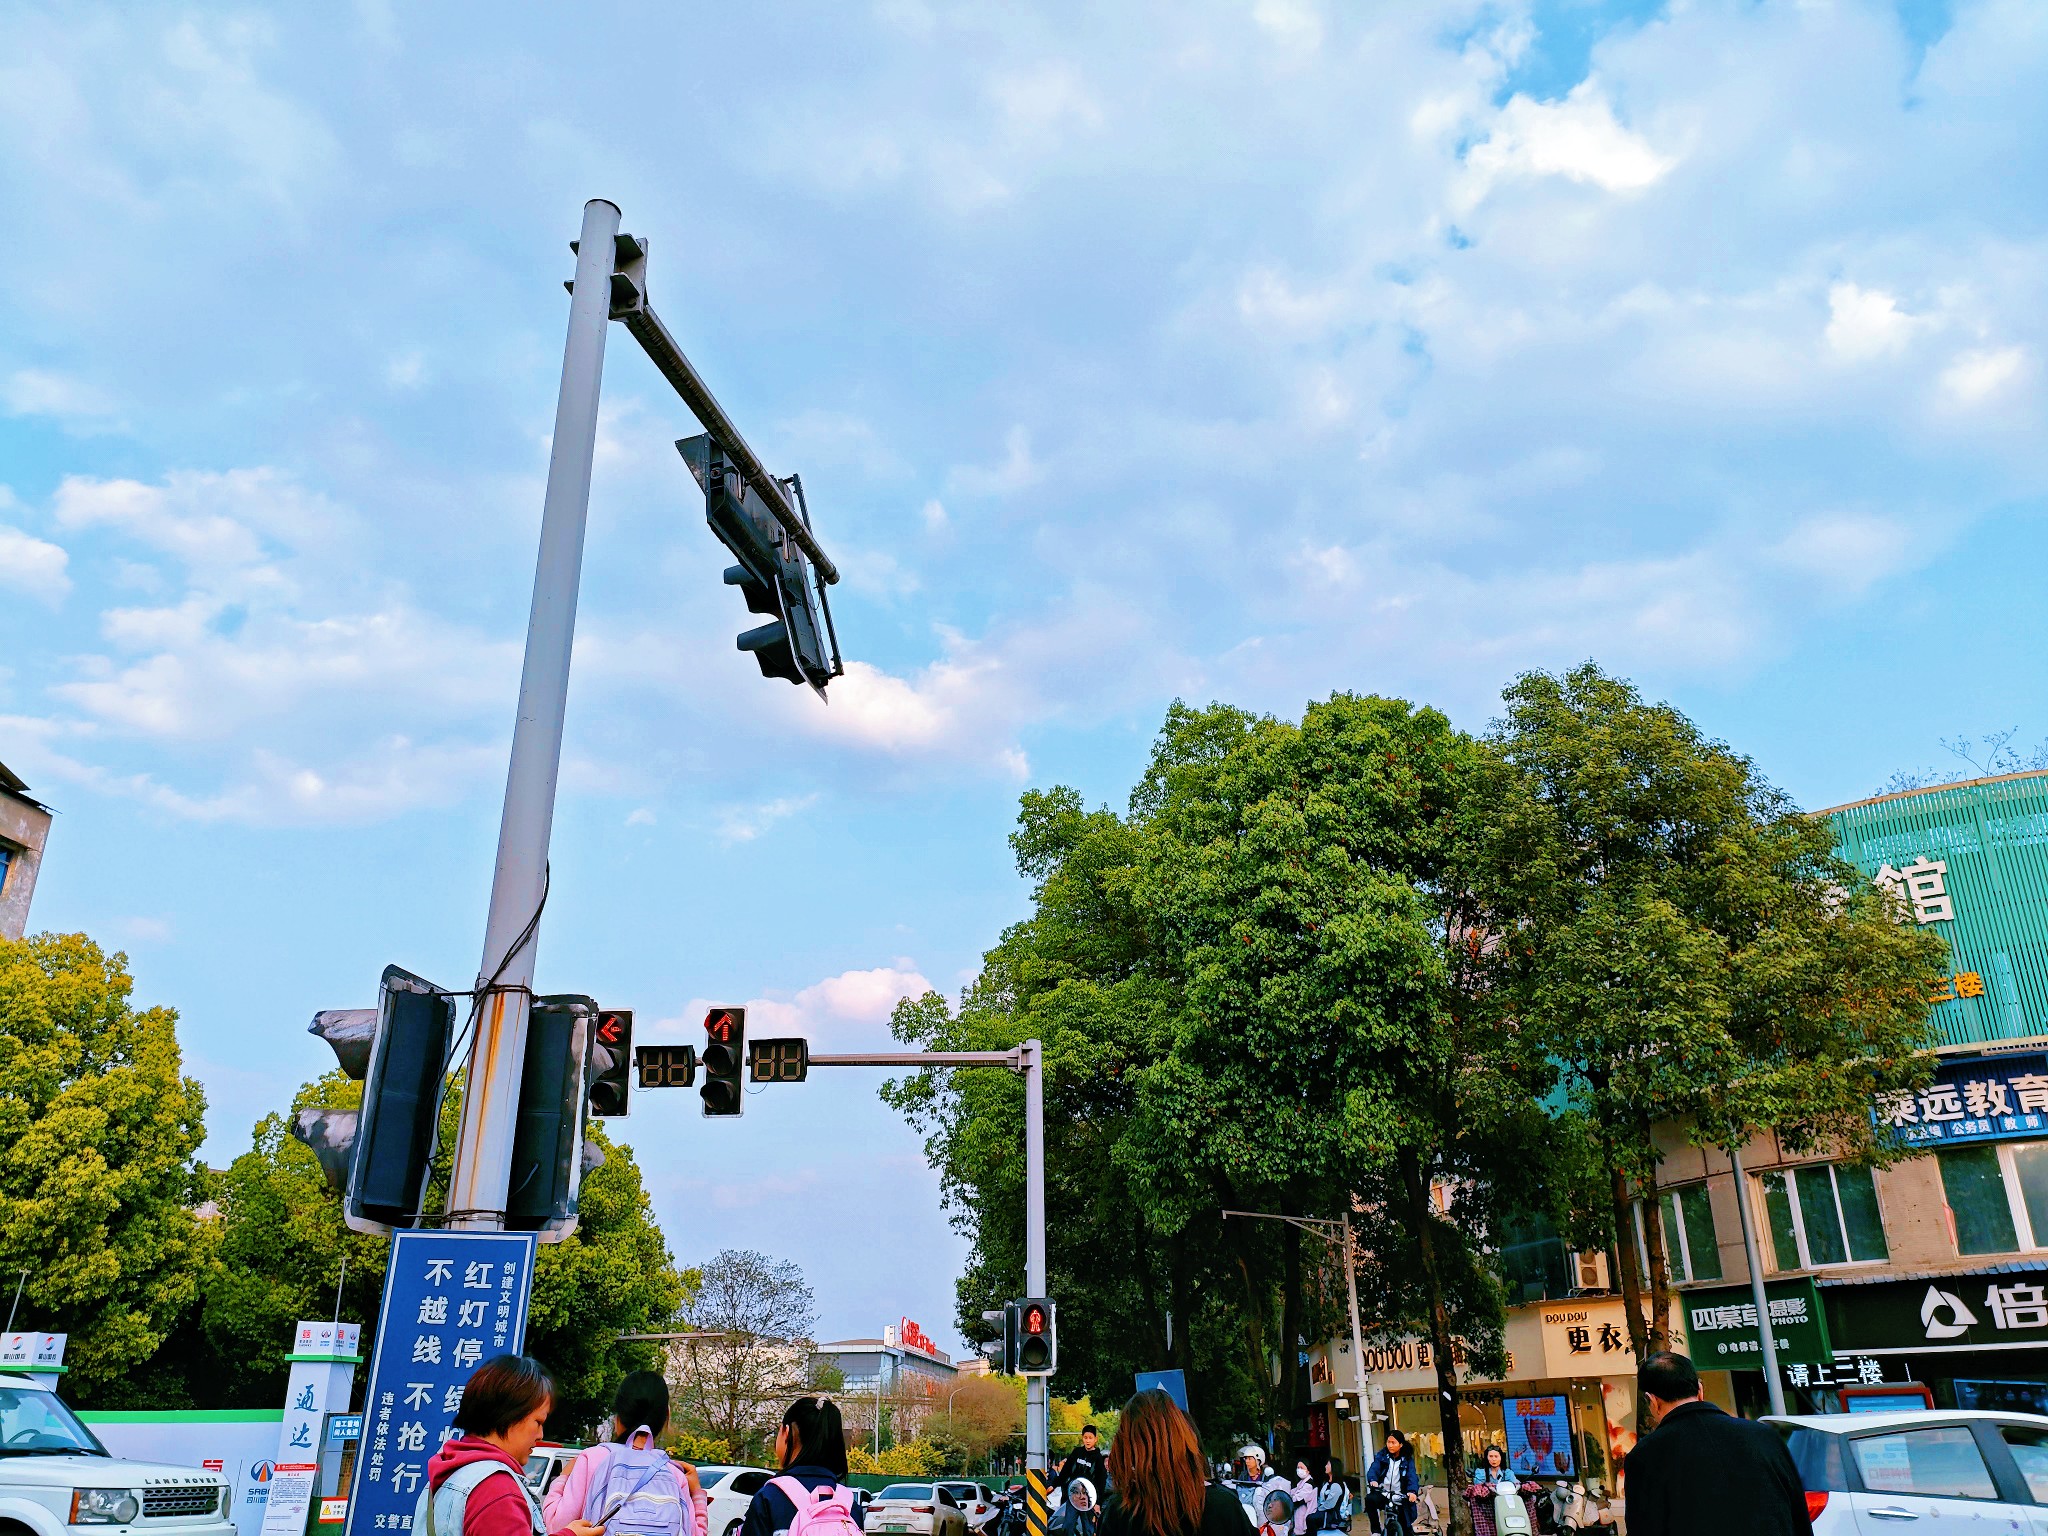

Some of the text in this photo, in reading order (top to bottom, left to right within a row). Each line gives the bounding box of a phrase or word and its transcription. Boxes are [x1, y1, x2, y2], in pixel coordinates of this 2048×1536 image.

[1951, 1118, 1991, 1135] 公务员
[493, 1261, 517, 1348] 创建文明城市
[1771, 1316, 1809, 1326] PHOTO
[1984, 1283, 2048, 1329] 倍
[289, 1383, 318, 1448] 通达
[368, 1392, 395, 1482] 违者依法处罚
